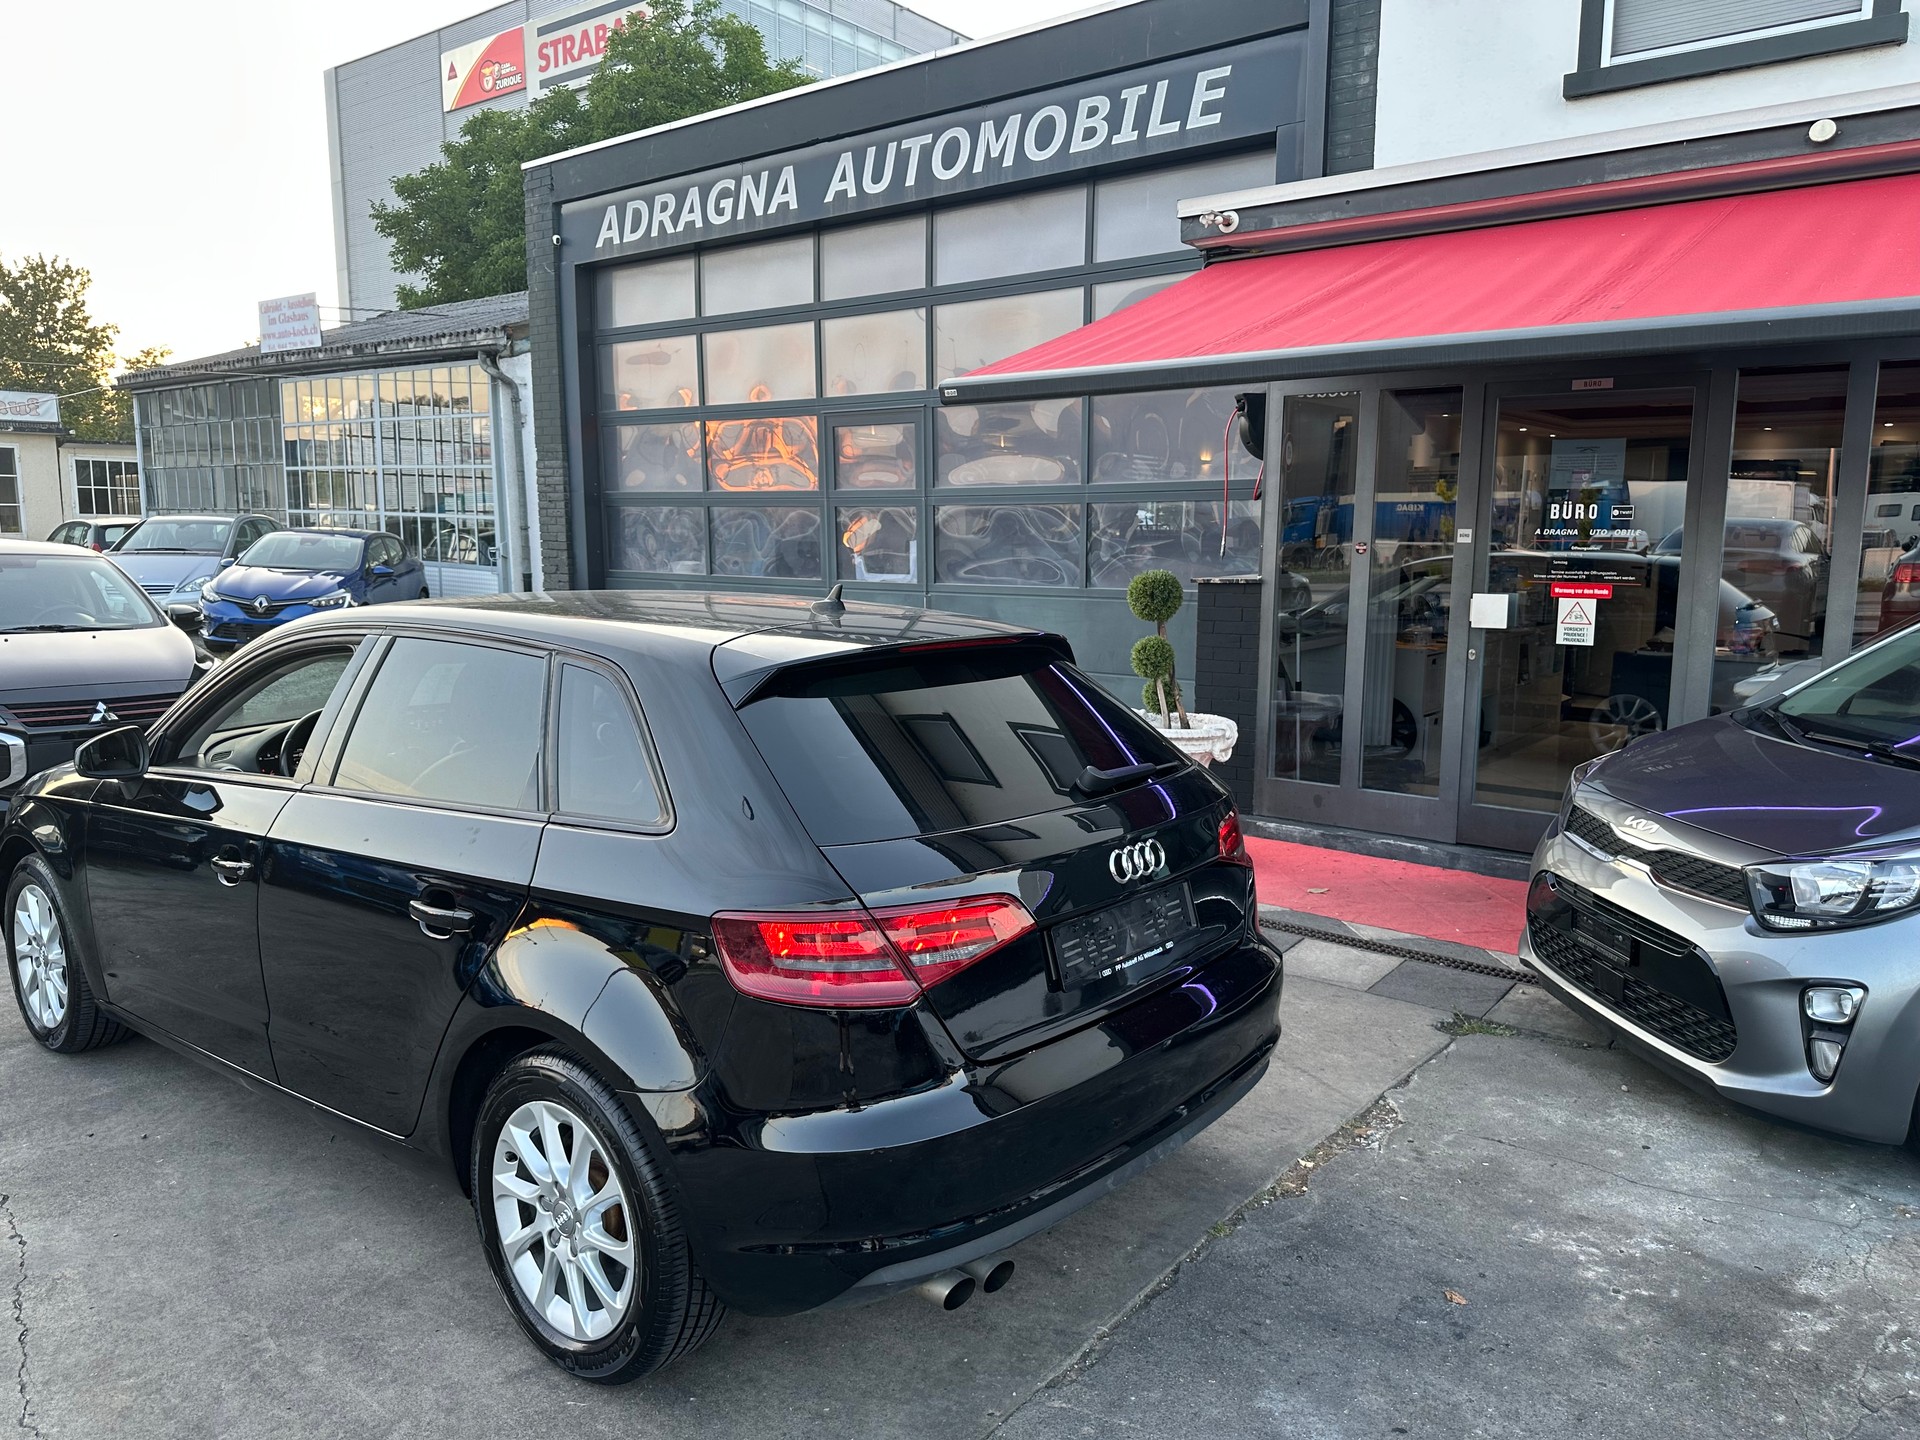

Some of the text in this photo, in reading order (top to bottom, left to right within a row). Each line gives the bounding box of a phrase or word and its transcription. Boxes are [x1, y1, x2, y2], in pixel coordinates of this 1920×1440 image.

[495, 73, 523, 90] ZURIQUE
[595, 64, 1232, 249] ADRAGNA AUTOMOBILE
[1550, 501, 1598, 519] BÜRO
[1554, 587, 1574, 595] Warnung
[1624, 815, 1660, 835] KIA
